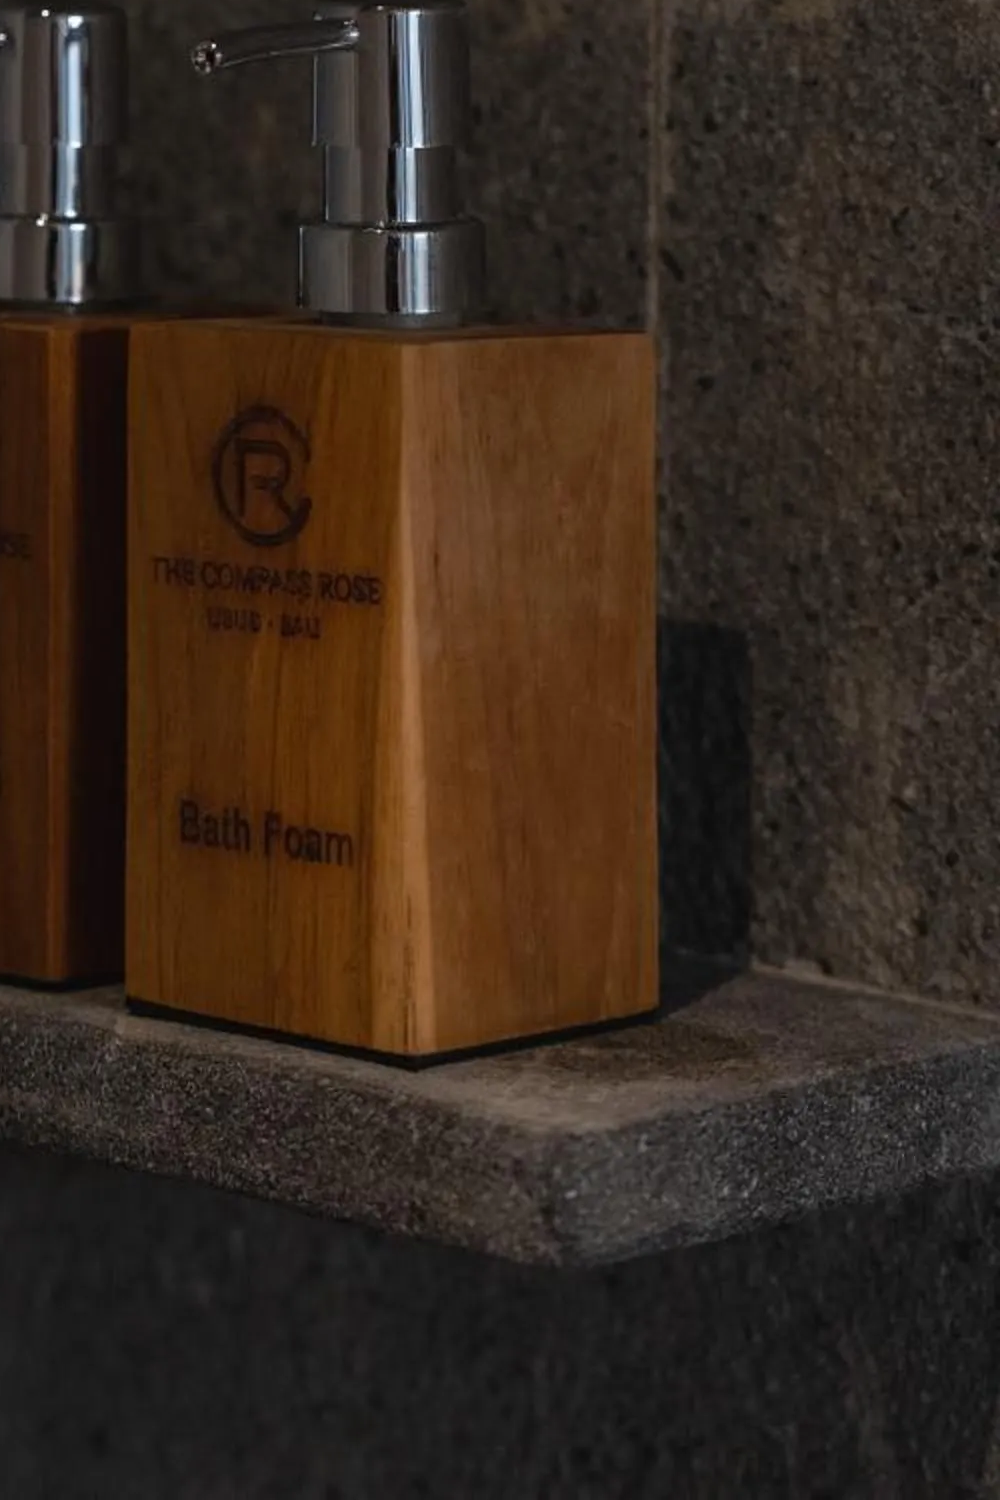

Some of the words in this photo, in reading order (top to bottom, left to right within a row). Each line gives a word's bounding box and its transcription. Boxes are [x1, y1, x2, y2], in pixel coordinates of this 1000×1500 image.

[151, 555, 195, 587] THE
[200, 560, 312, 598] COMPASS
[317, 571, 383, 605] ROSE
[179, 799, 250, 854] Bath
[263, 810, 354, 868] Foam
